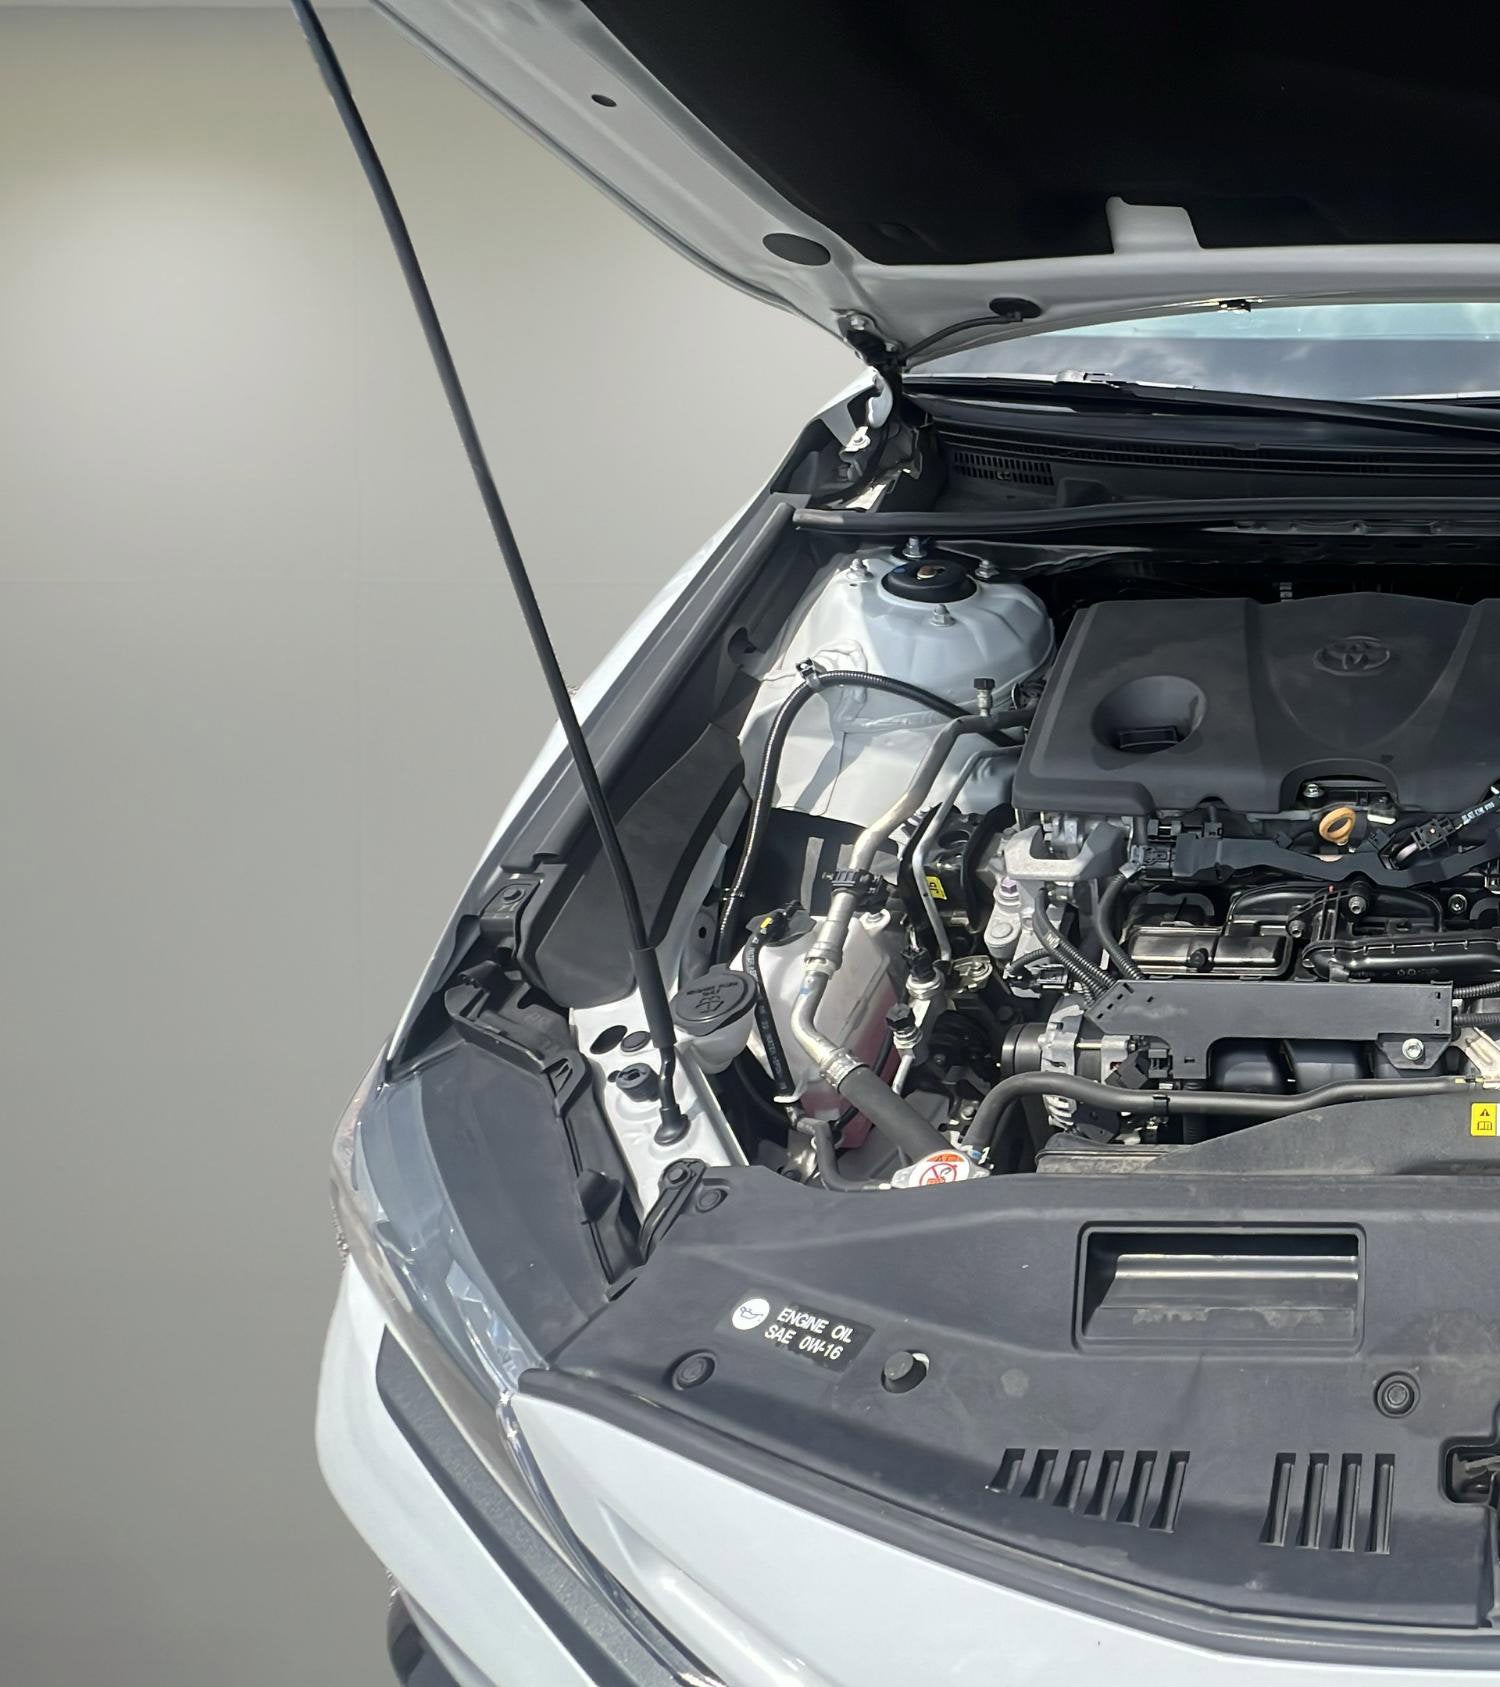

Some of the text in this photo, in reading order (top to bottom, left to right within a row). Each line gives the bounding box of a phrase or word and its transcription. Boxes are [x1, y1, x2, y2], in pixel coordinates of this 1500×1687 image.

[764, 1324, 844, 1360] SAE 0W-16
[776, 1307, 854, 1343] ENGINE OIL
